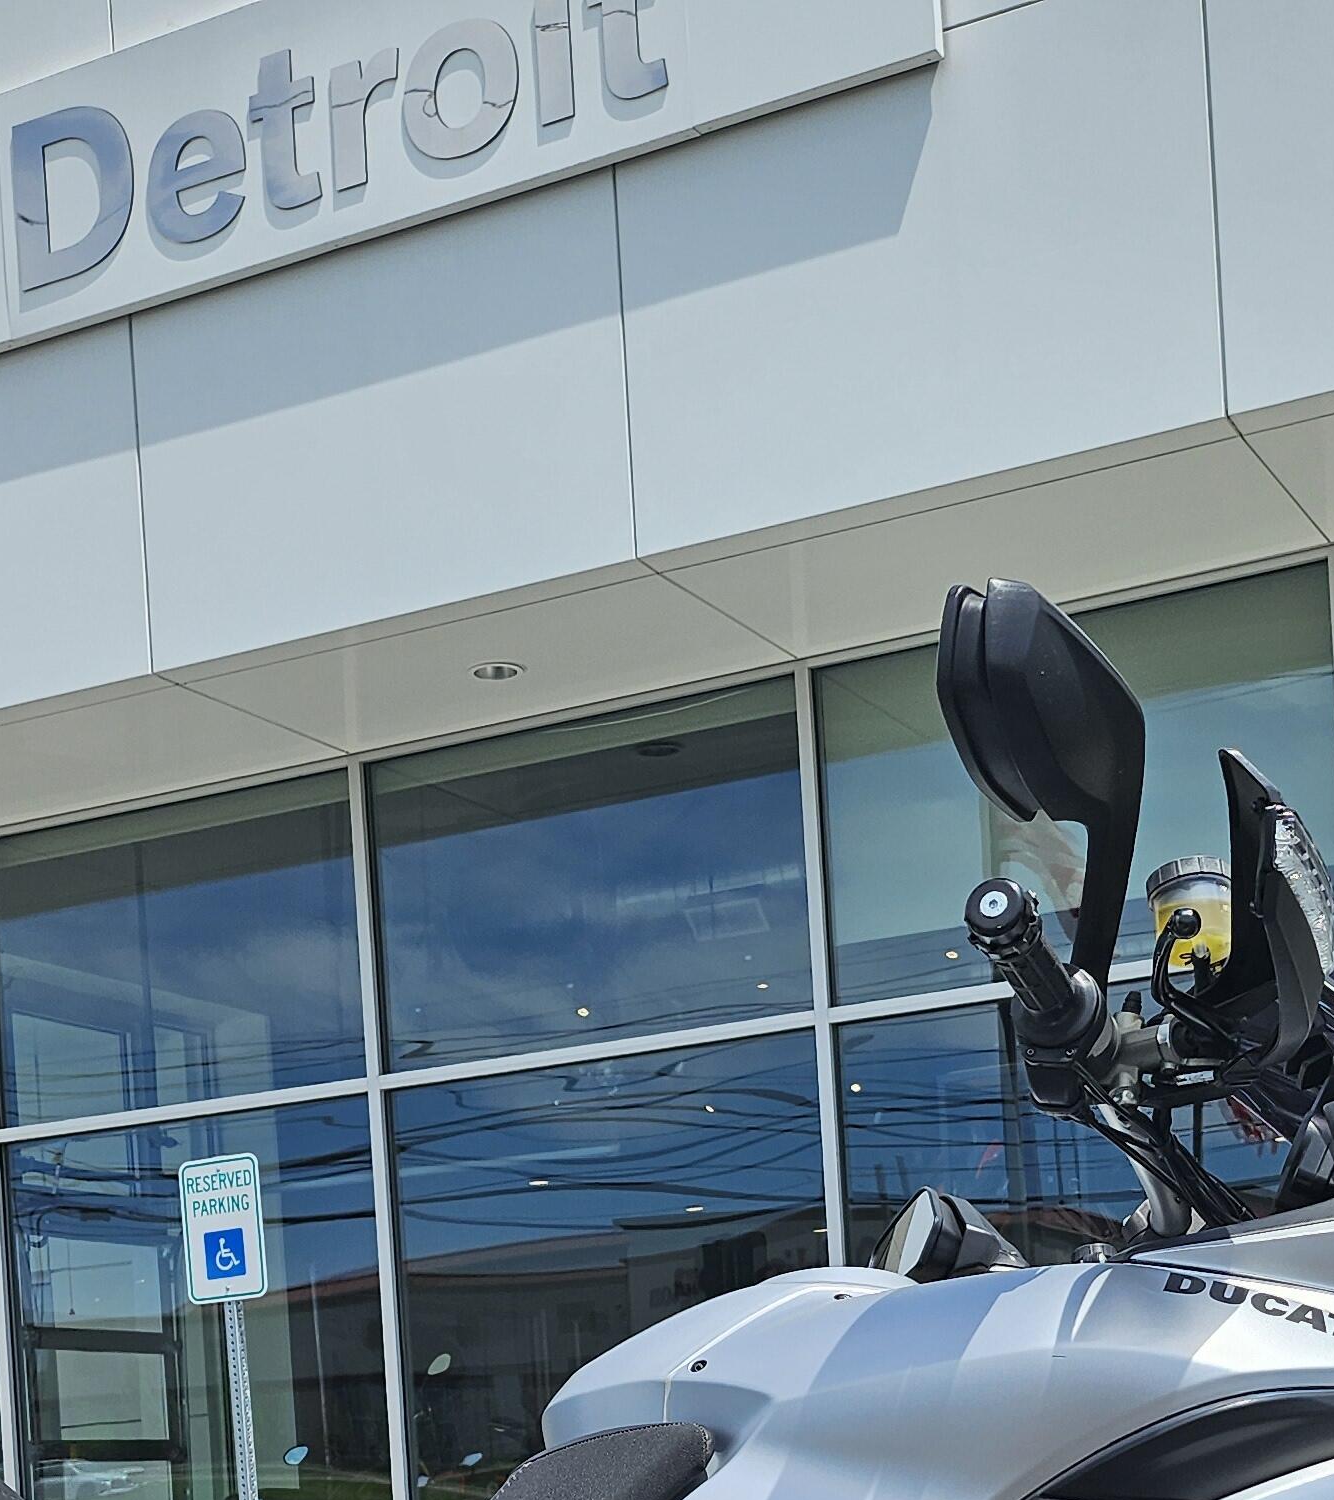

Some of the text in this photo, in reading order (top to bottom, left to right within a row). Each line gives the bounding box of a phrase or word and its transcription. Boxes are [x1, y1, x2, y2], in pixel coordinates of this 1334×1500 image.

[10, 0, 669, 292] Detroit
[186, 1169, 252, 1195] RESERVED
[193, 1194, 250, 1218] PARKING
